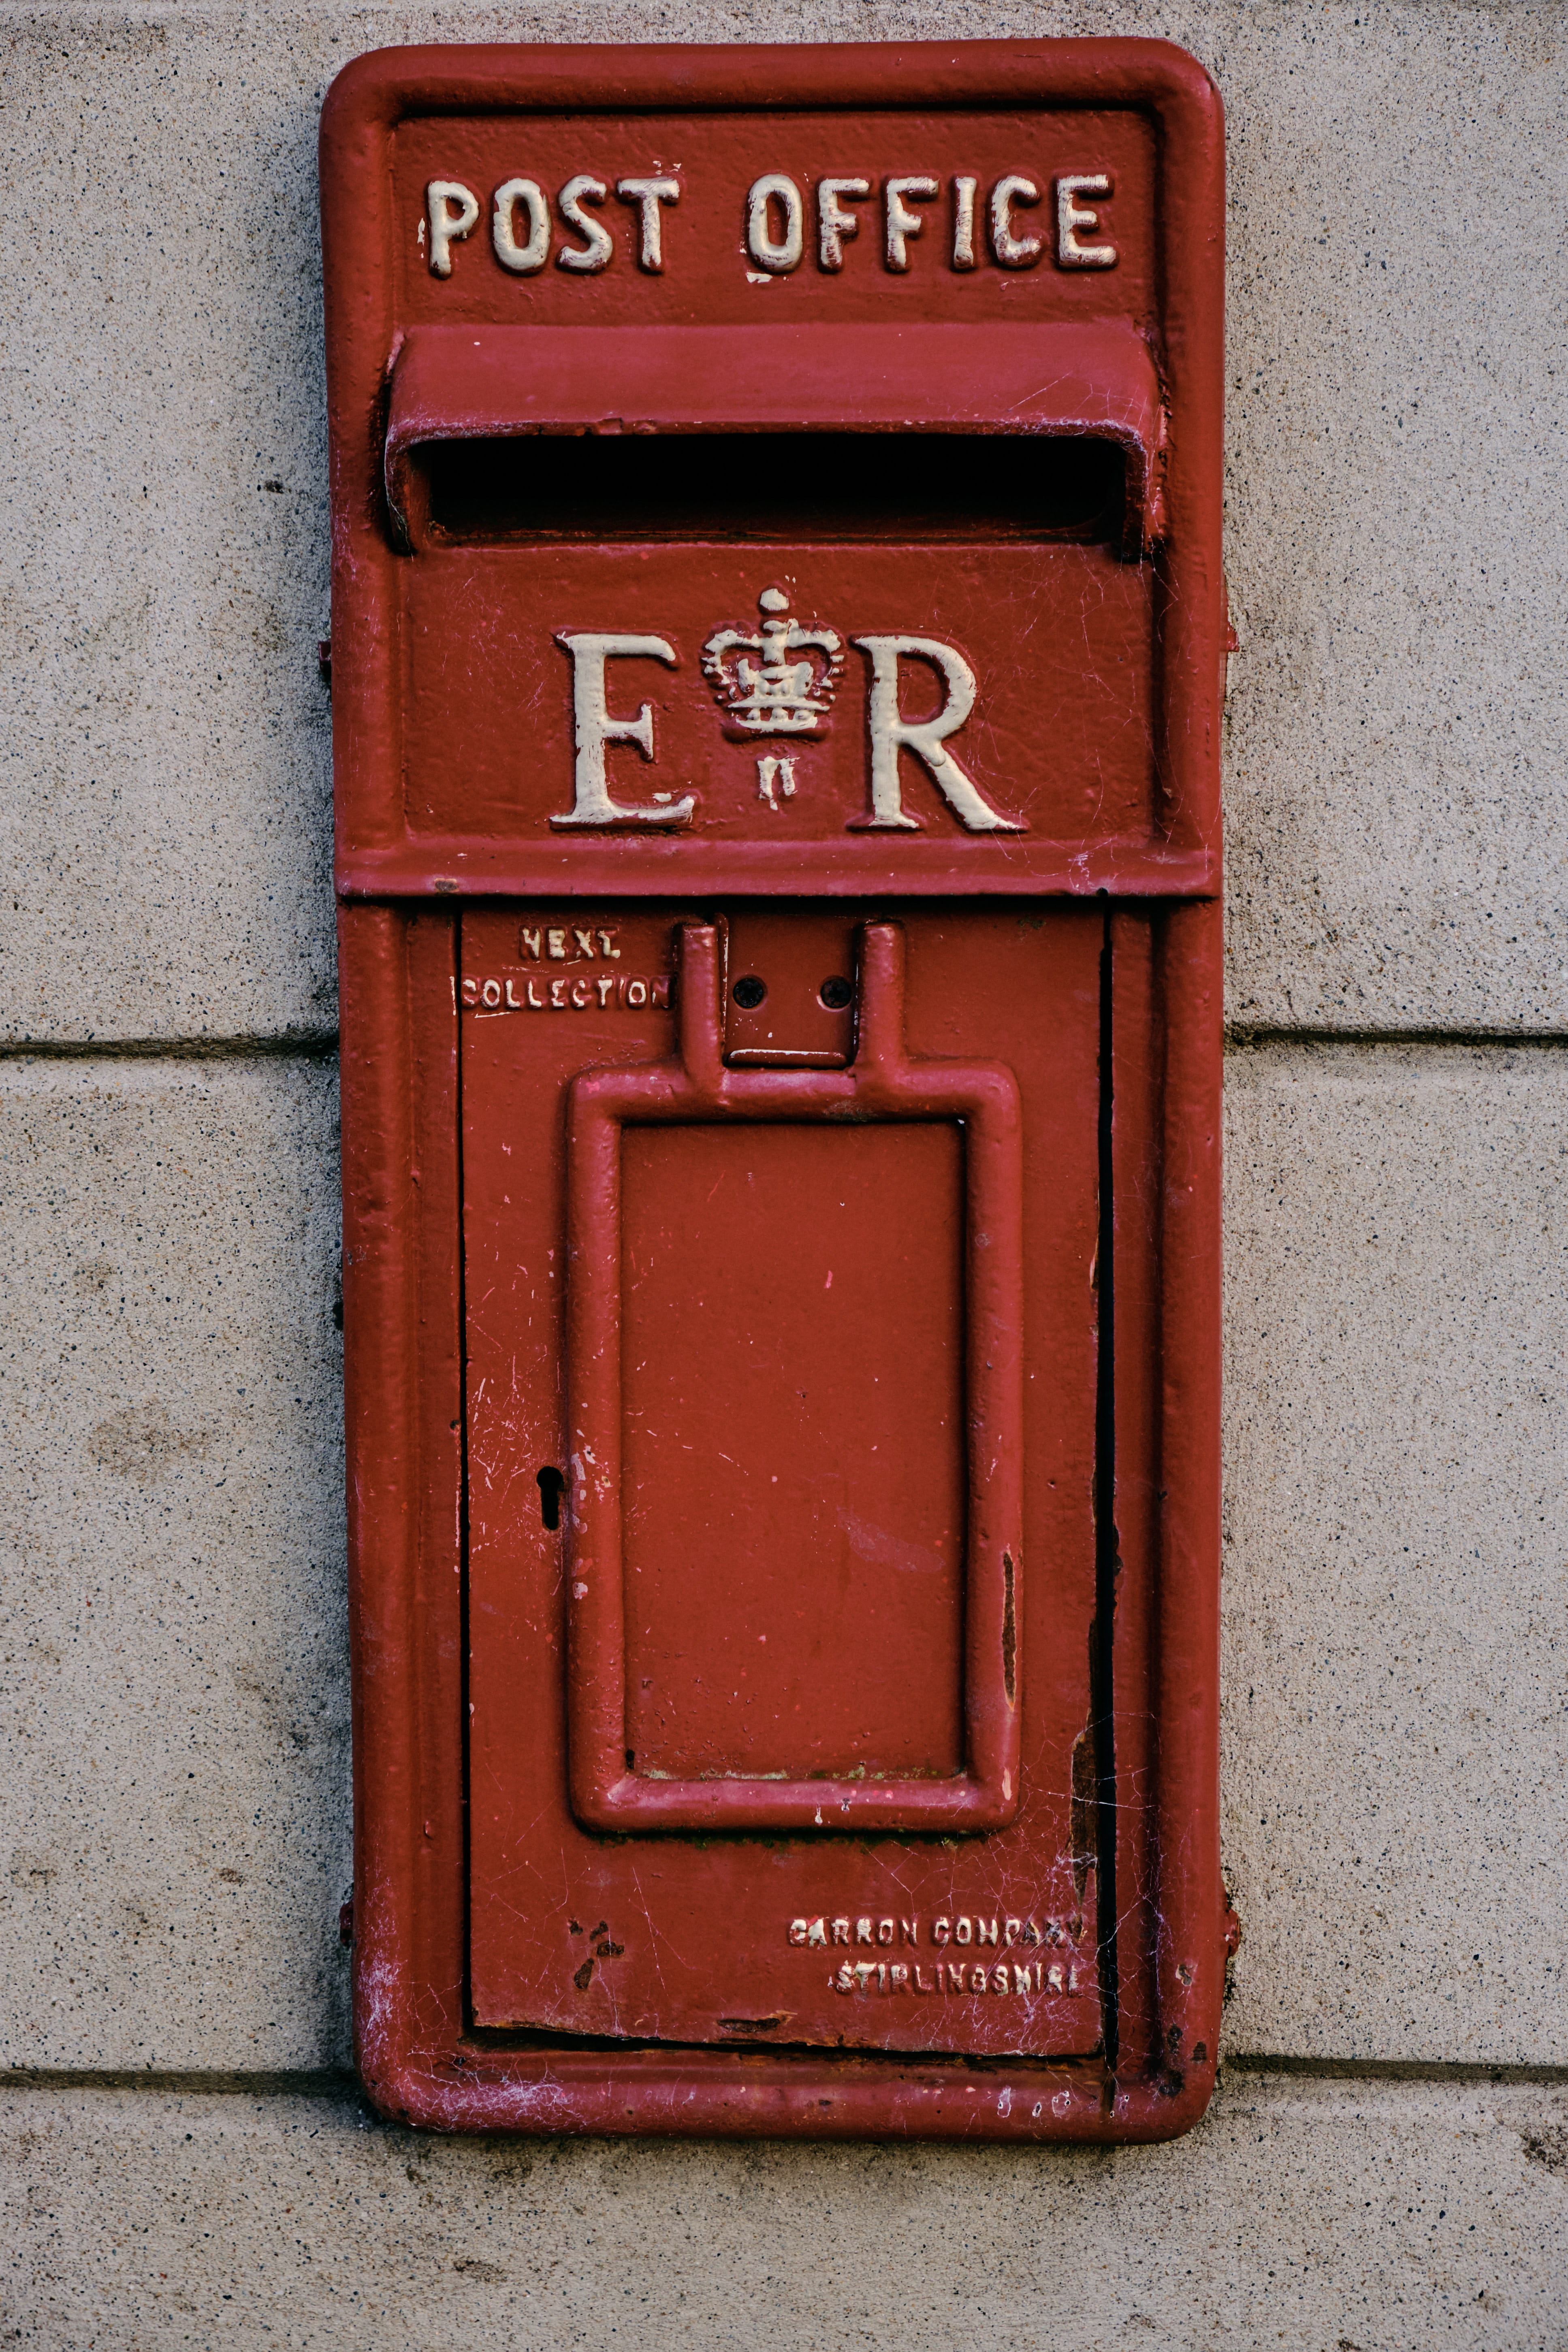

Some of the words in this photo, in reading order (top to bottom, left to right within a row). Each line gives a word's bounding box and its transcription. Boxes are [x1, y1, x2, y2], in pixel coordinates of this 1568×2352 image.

[427, 174, 681, 278] POST
[747, 174, 1119, 272] OFFICE
[549, 630, 697, 828] E
[847, 633, 1028, 832] R
[520, 926, 621, 959] NEXT
[462, 975, 670, 1009] COLLECTION
[789, 1918, 917, 1947] CARRON
